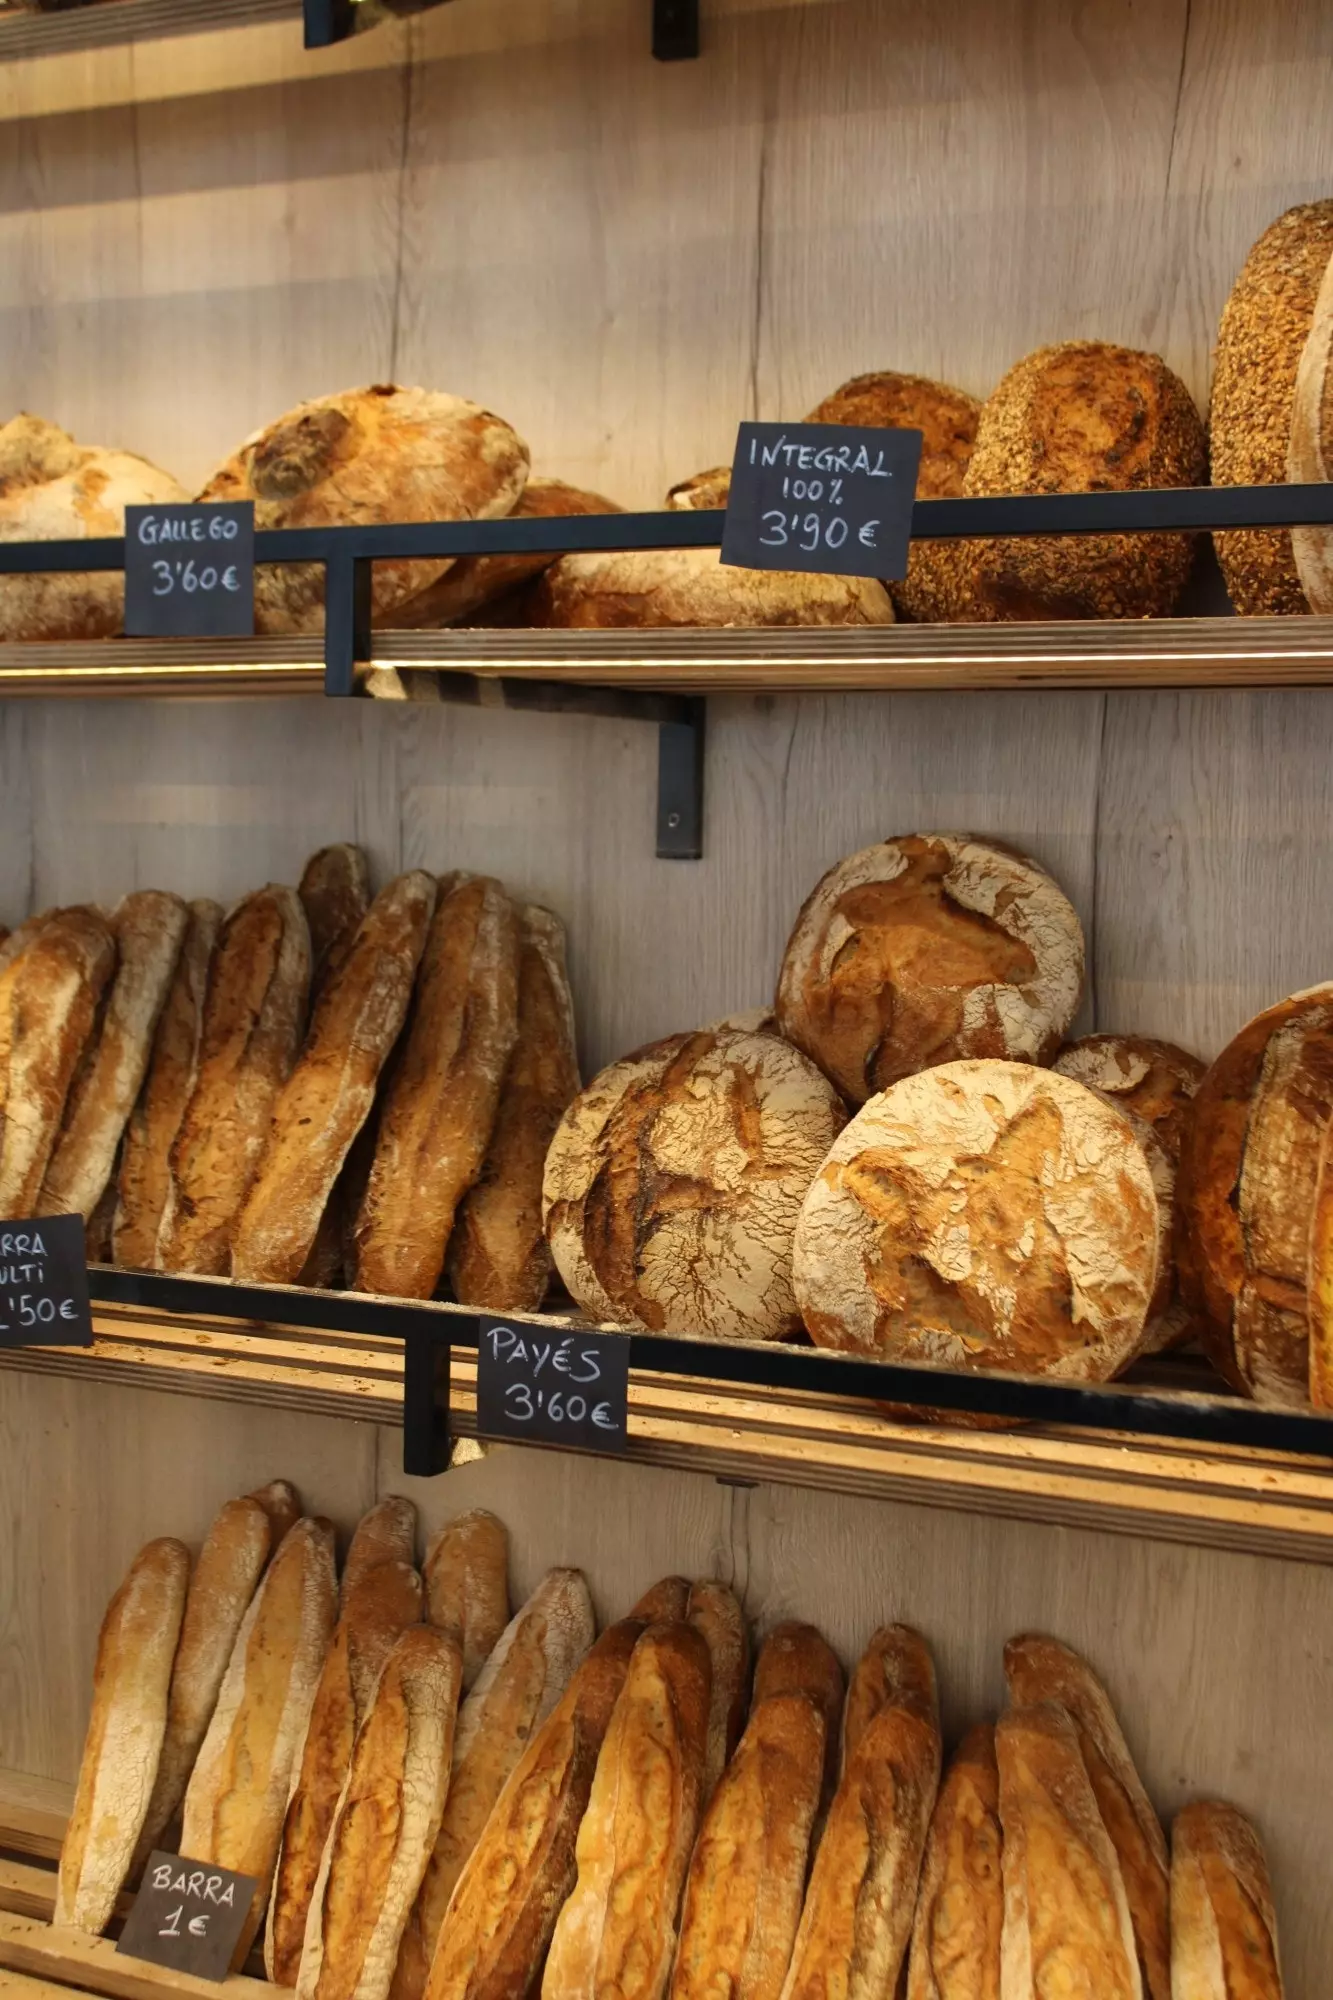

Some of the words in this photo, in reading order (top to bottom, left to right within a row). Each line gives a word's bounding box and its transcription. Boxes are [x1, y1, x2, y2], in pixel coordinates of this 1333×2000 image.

[750, 434, 893, 477] INTEGRAL
[138, 515, 239, 545] GALLEGO
[151, 560, 241, 596] 3'60€
[0, 1232, 49, 1257] RRA
[0, 1262, 44, 1285] ULTi
[486, 1326, 601, 1382] PAYÉS
[504, 1382, 619, 1430] 3'60€
[152, 1864, 235, 1908] BARRA
